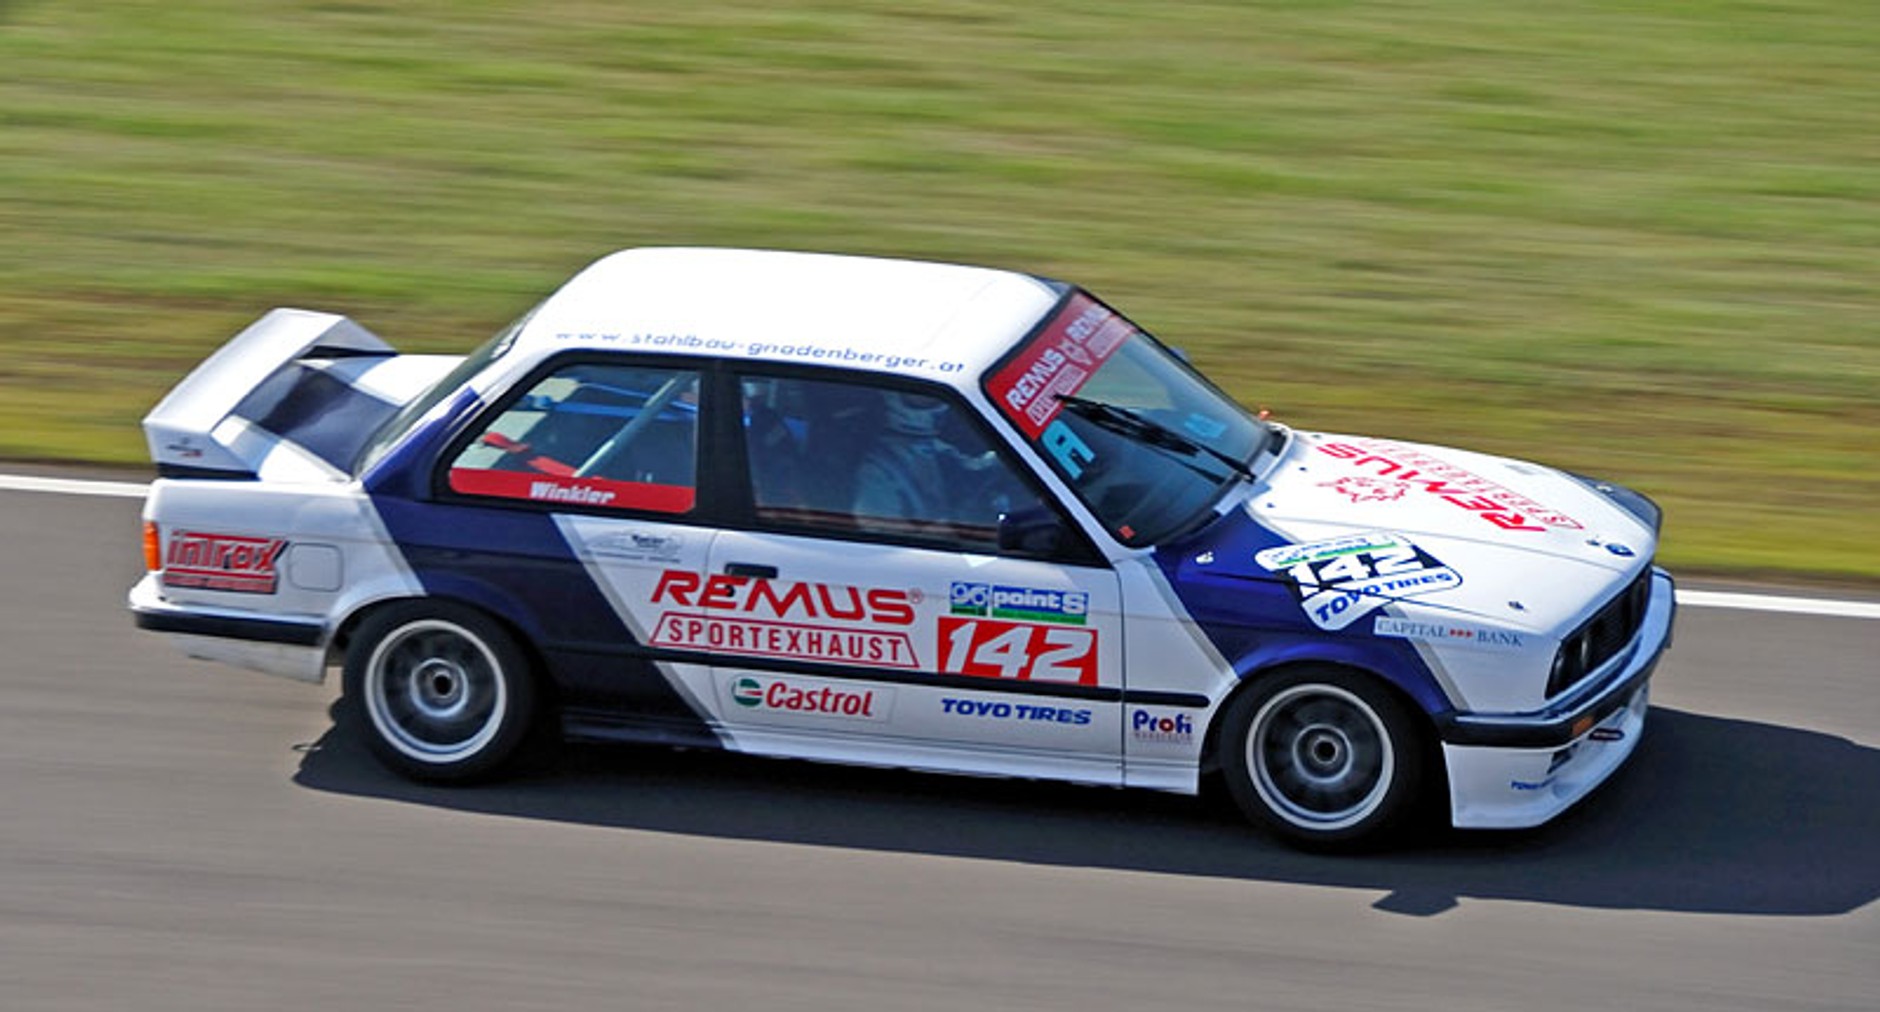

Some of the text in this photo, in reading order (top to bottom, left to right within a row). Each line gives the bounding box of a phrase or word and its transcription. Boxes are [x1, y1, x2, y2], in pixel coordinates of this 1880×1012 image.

[555, 332, 966, 373] www.stahlbau-gnadenberger.at
[1005, 349, 1067, 411] REMUS
[1041, 419, 1095, 480] A
[530, 481, 616, 505] Winkler
[1316, 442, 1548, 532] REMUS
[1288, 547, 1425, 598] 142
[651, 569, 915, 626] REMUS
[1316, 572, 1452, 623] TOYO TIRES
[668, 618, 904, 662] SPORTEXHAUST
[944, 621, 1094, 684] 142
[1377, 619, 1523, 648] CAPITAL BANK
[765, 682, 874, 717] Castrol
[941, 698, 1093, 726] TOYO TIRES
[1132, 709, 1193, 734] Profi
